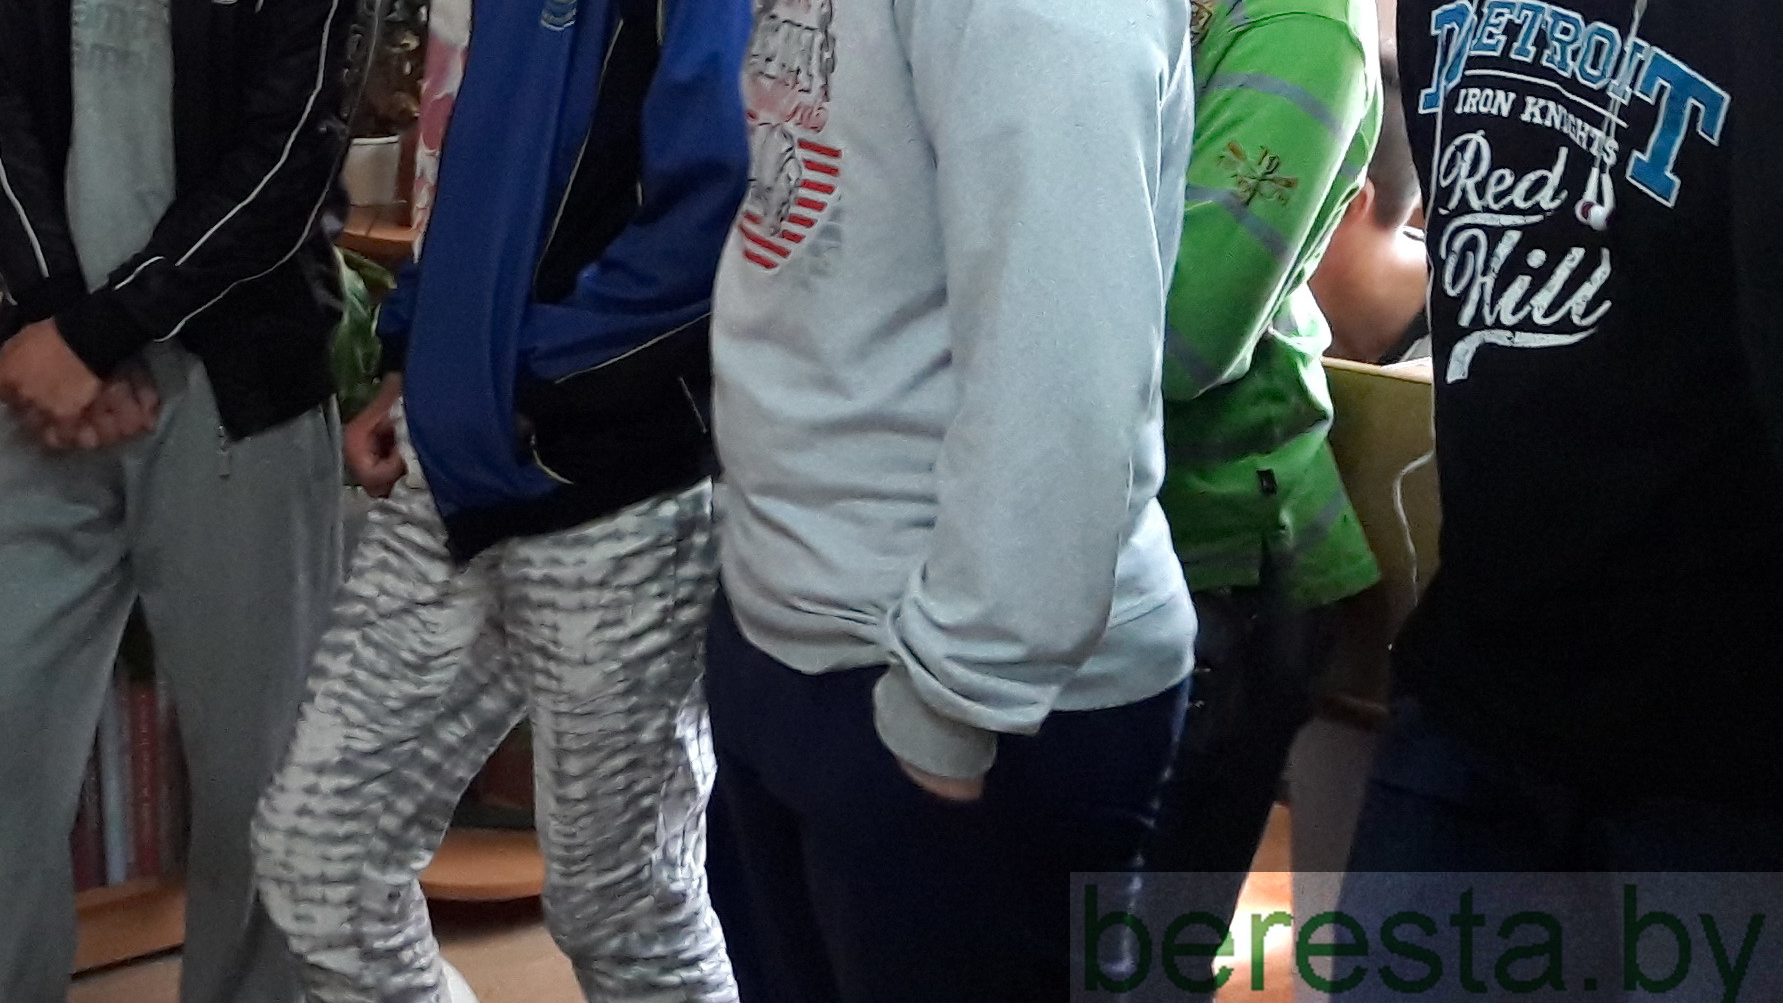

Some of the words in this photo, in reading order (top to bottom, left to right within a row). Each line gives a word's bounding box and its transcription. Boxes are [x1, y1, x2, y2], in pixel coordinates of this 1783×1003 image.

[1454, 87, 1516, 117] IRON
[1520, 95, 1620, 166] KNIGHTS
[1438, 129, 1570, 215] Red
